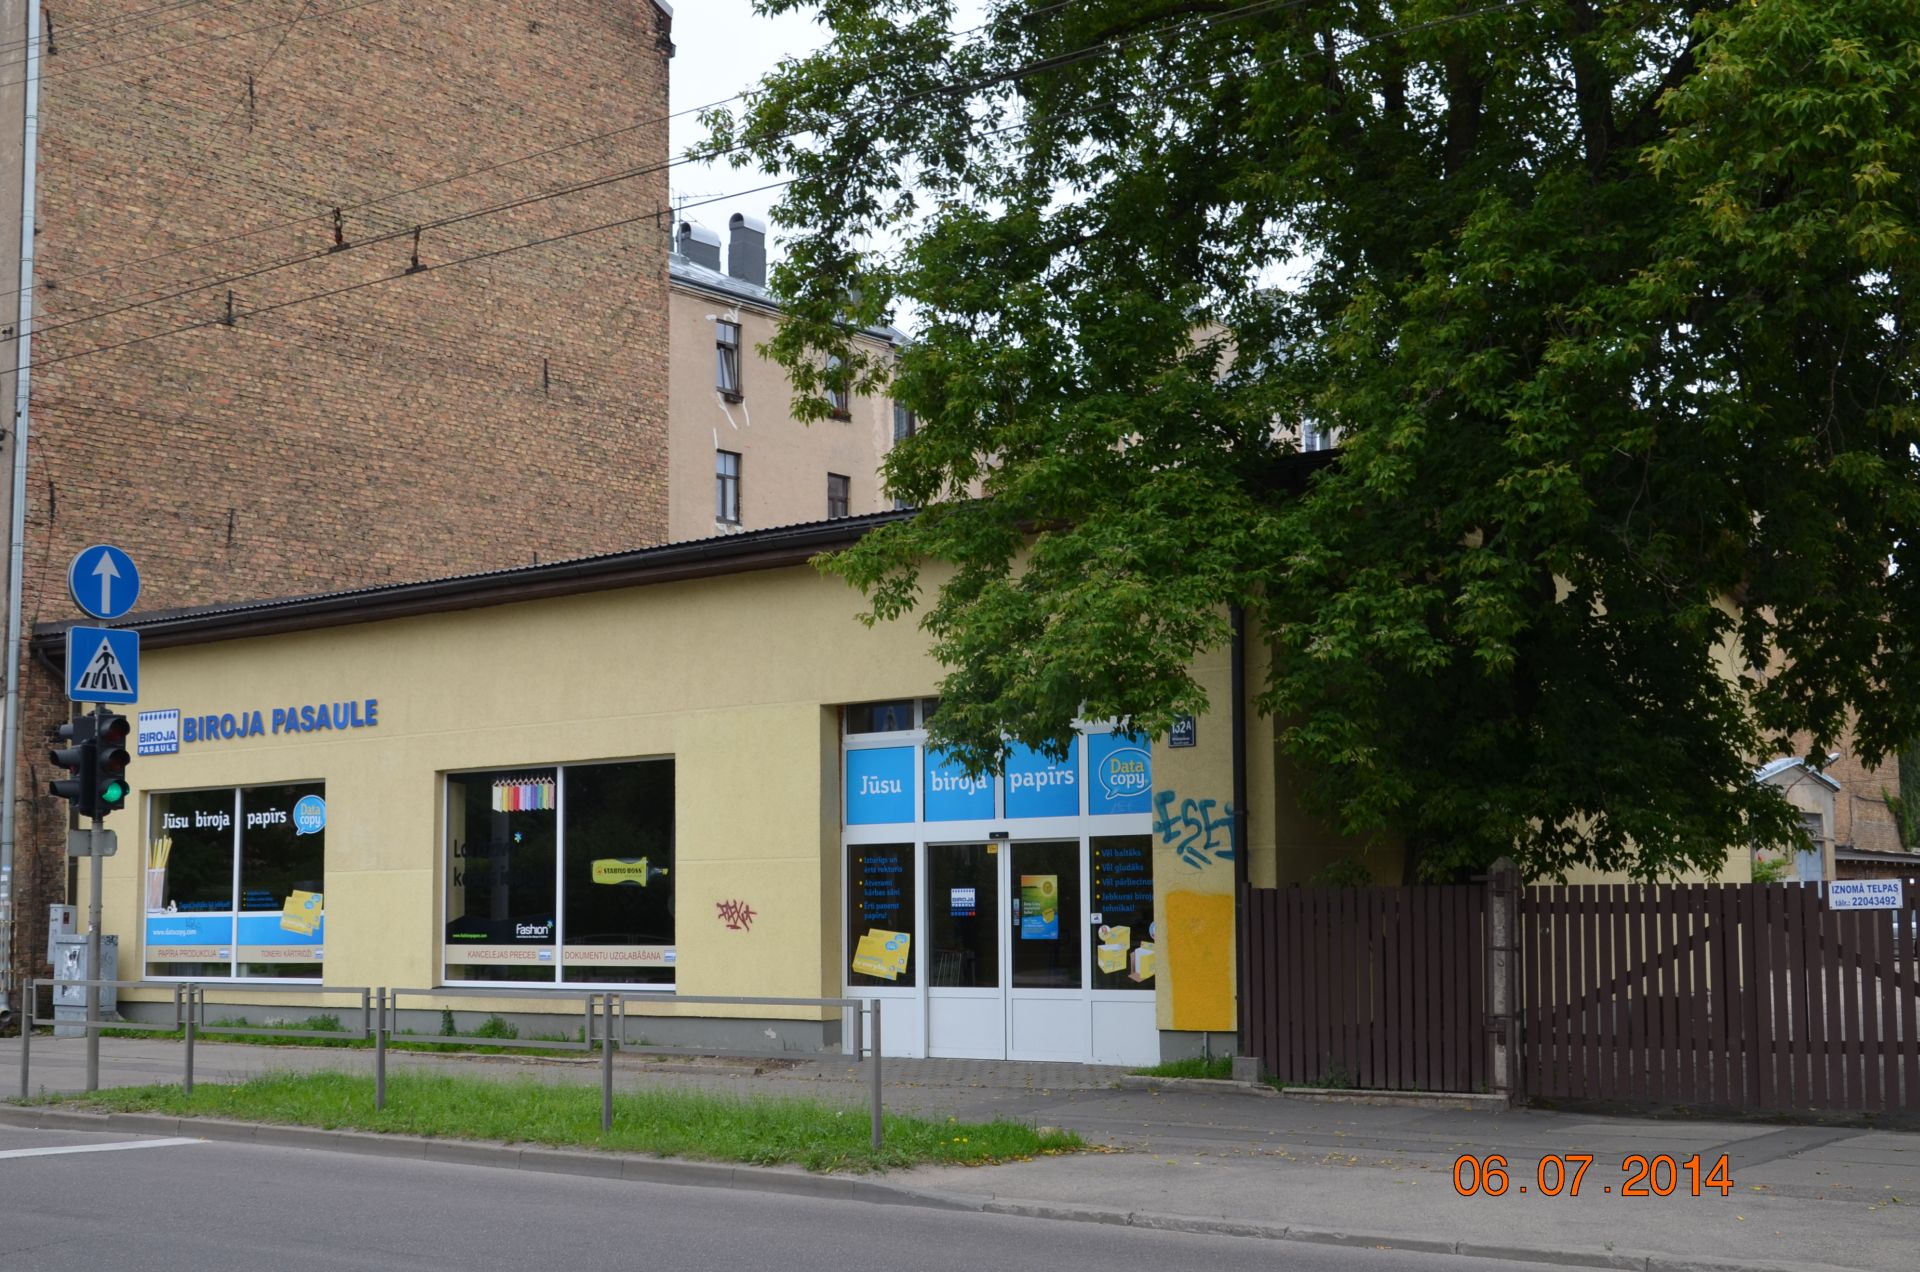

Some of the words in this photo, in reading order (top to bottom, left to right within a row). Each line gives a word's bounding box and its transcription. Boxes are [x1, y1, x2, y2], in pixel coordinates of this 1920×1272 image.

[183, 711, 265, 742] BIROJA
[272, 699, 378, 734] PASAULE
[139, 730, 176, 743] BIROJA
[138, 744, 177, 754] PASAULE
[1111, 758, 1145, 773] Data
[860, 775, 902, 795] Jūsu
[931, 771, 988, 795] biroja
[1010, 766, 1075, 793] papīrs
[1111, 772, 1145, 789] copy
[301, 804, 321, 815] Data
[162, 813, 190, 829] Jūsu
[195, 810, 231, 831] biroja
[247, 808, 287, 829] papīrs
[300, 814, 322, 828] copy
[1832, 883, 1865, 894] IZNOMĀ
[1867, 883, 1899, 893] TELPAS
[1852, 896, 1897, 906] 22043492
[516, 923, 549, 935] Fashion
[467, 951, 508, 960] KANCELEJAS
[509, 951, 536, 960] PRECES
[565, 951, 608, 960] DOKUMENTU
